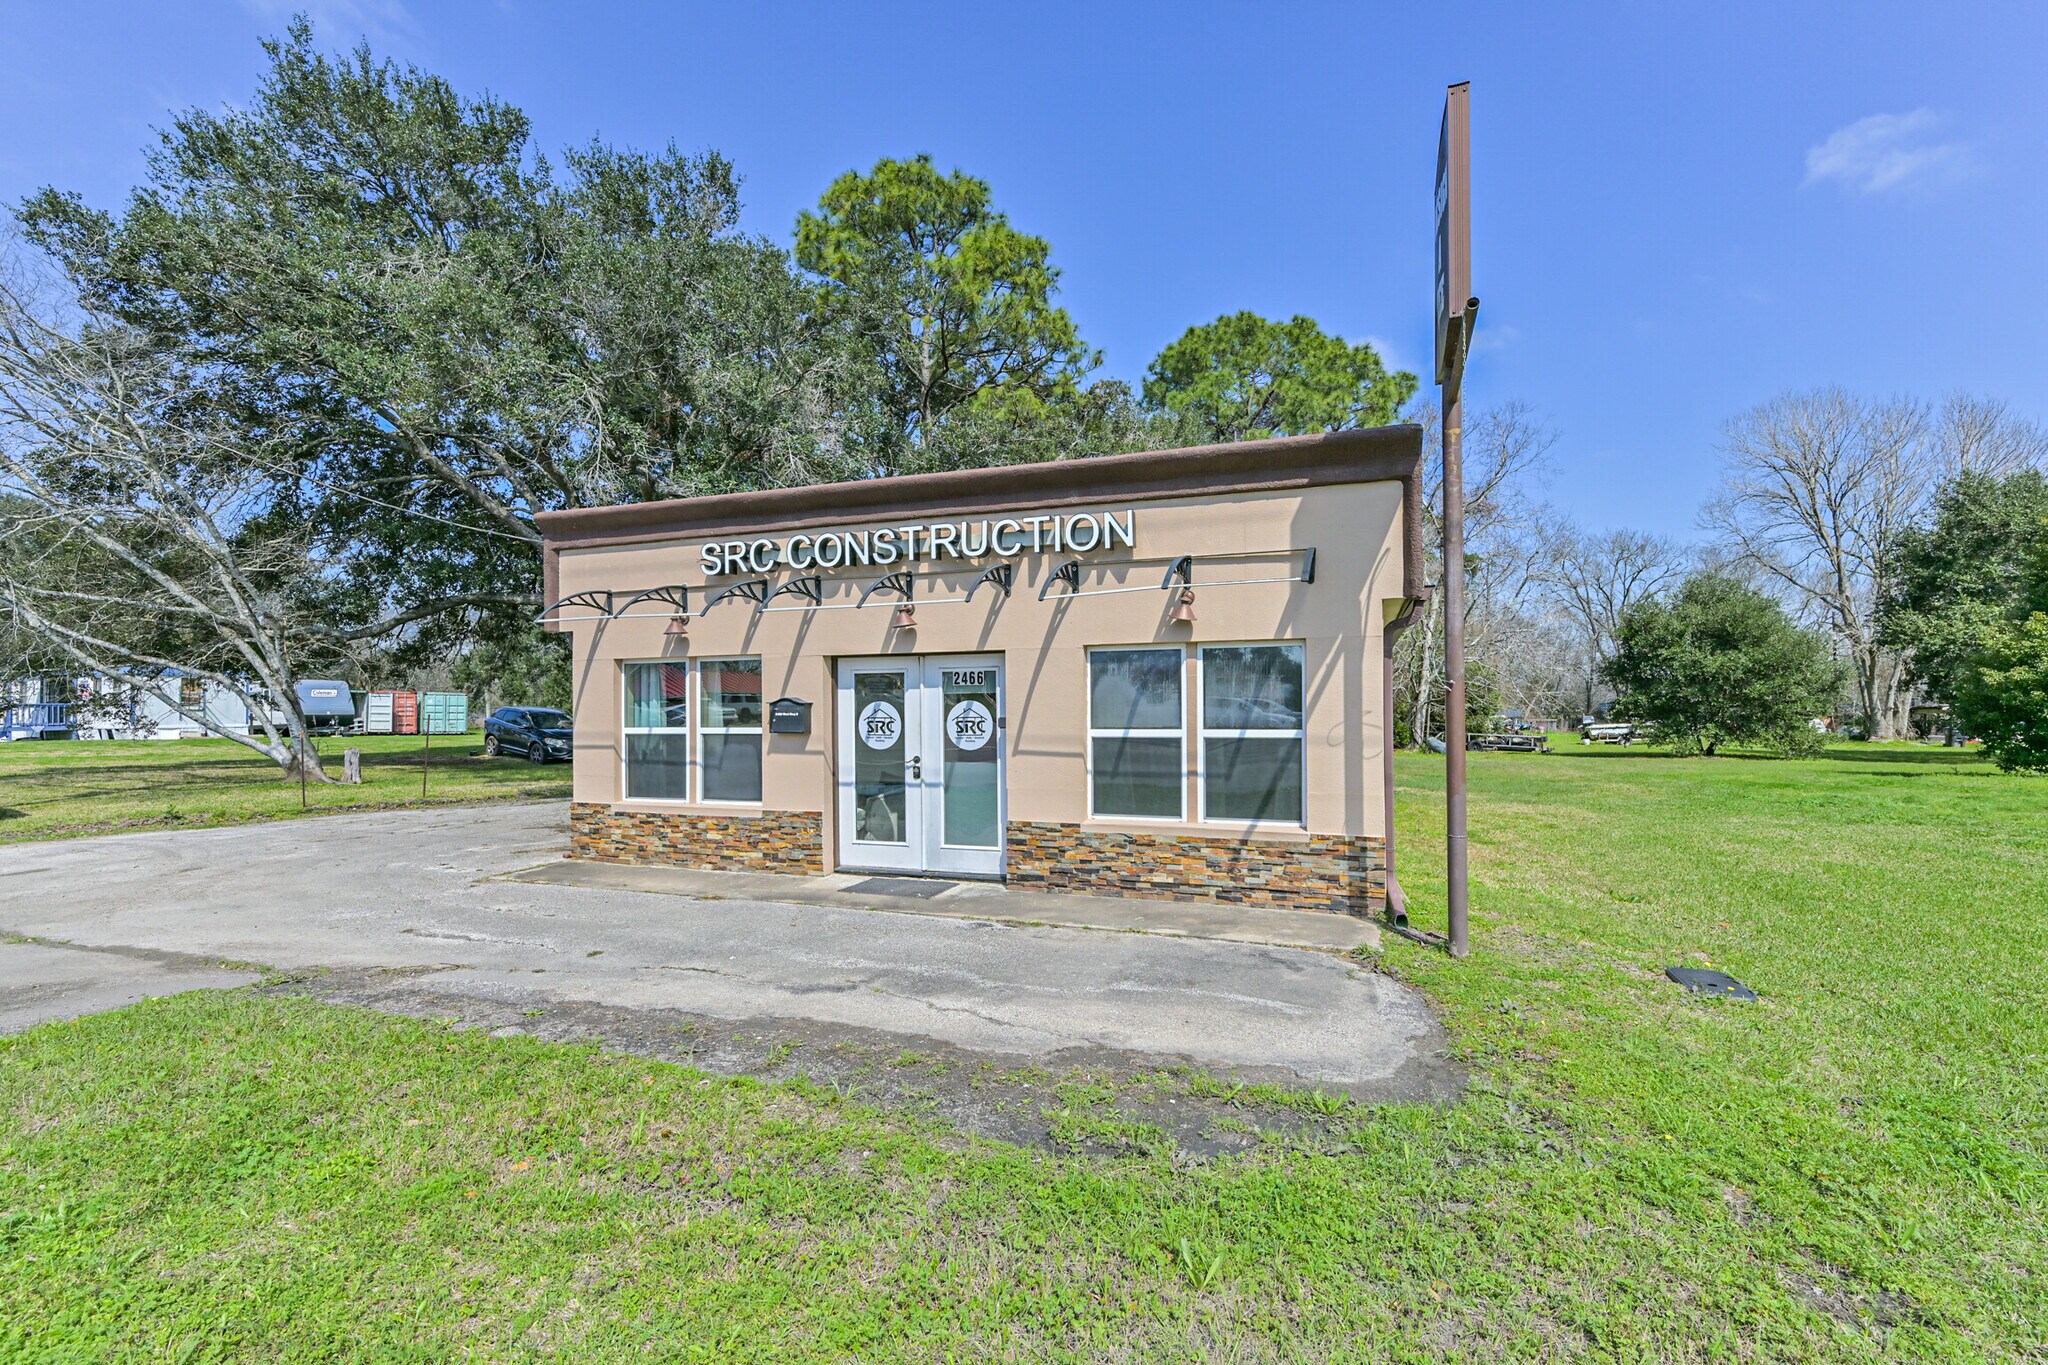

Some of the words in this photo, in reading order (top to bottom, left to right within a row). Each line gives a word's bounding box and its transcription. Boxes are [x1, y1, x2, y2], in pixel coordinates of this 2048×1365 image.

[700, 538, 777, 576] SRC
[786, 509, 1135, 571] CONSTRUCTION
[953, 671, 984, 685] 2466
[867, 720, 894, 734] SRC
[955, 720, 985, 734] SRC
